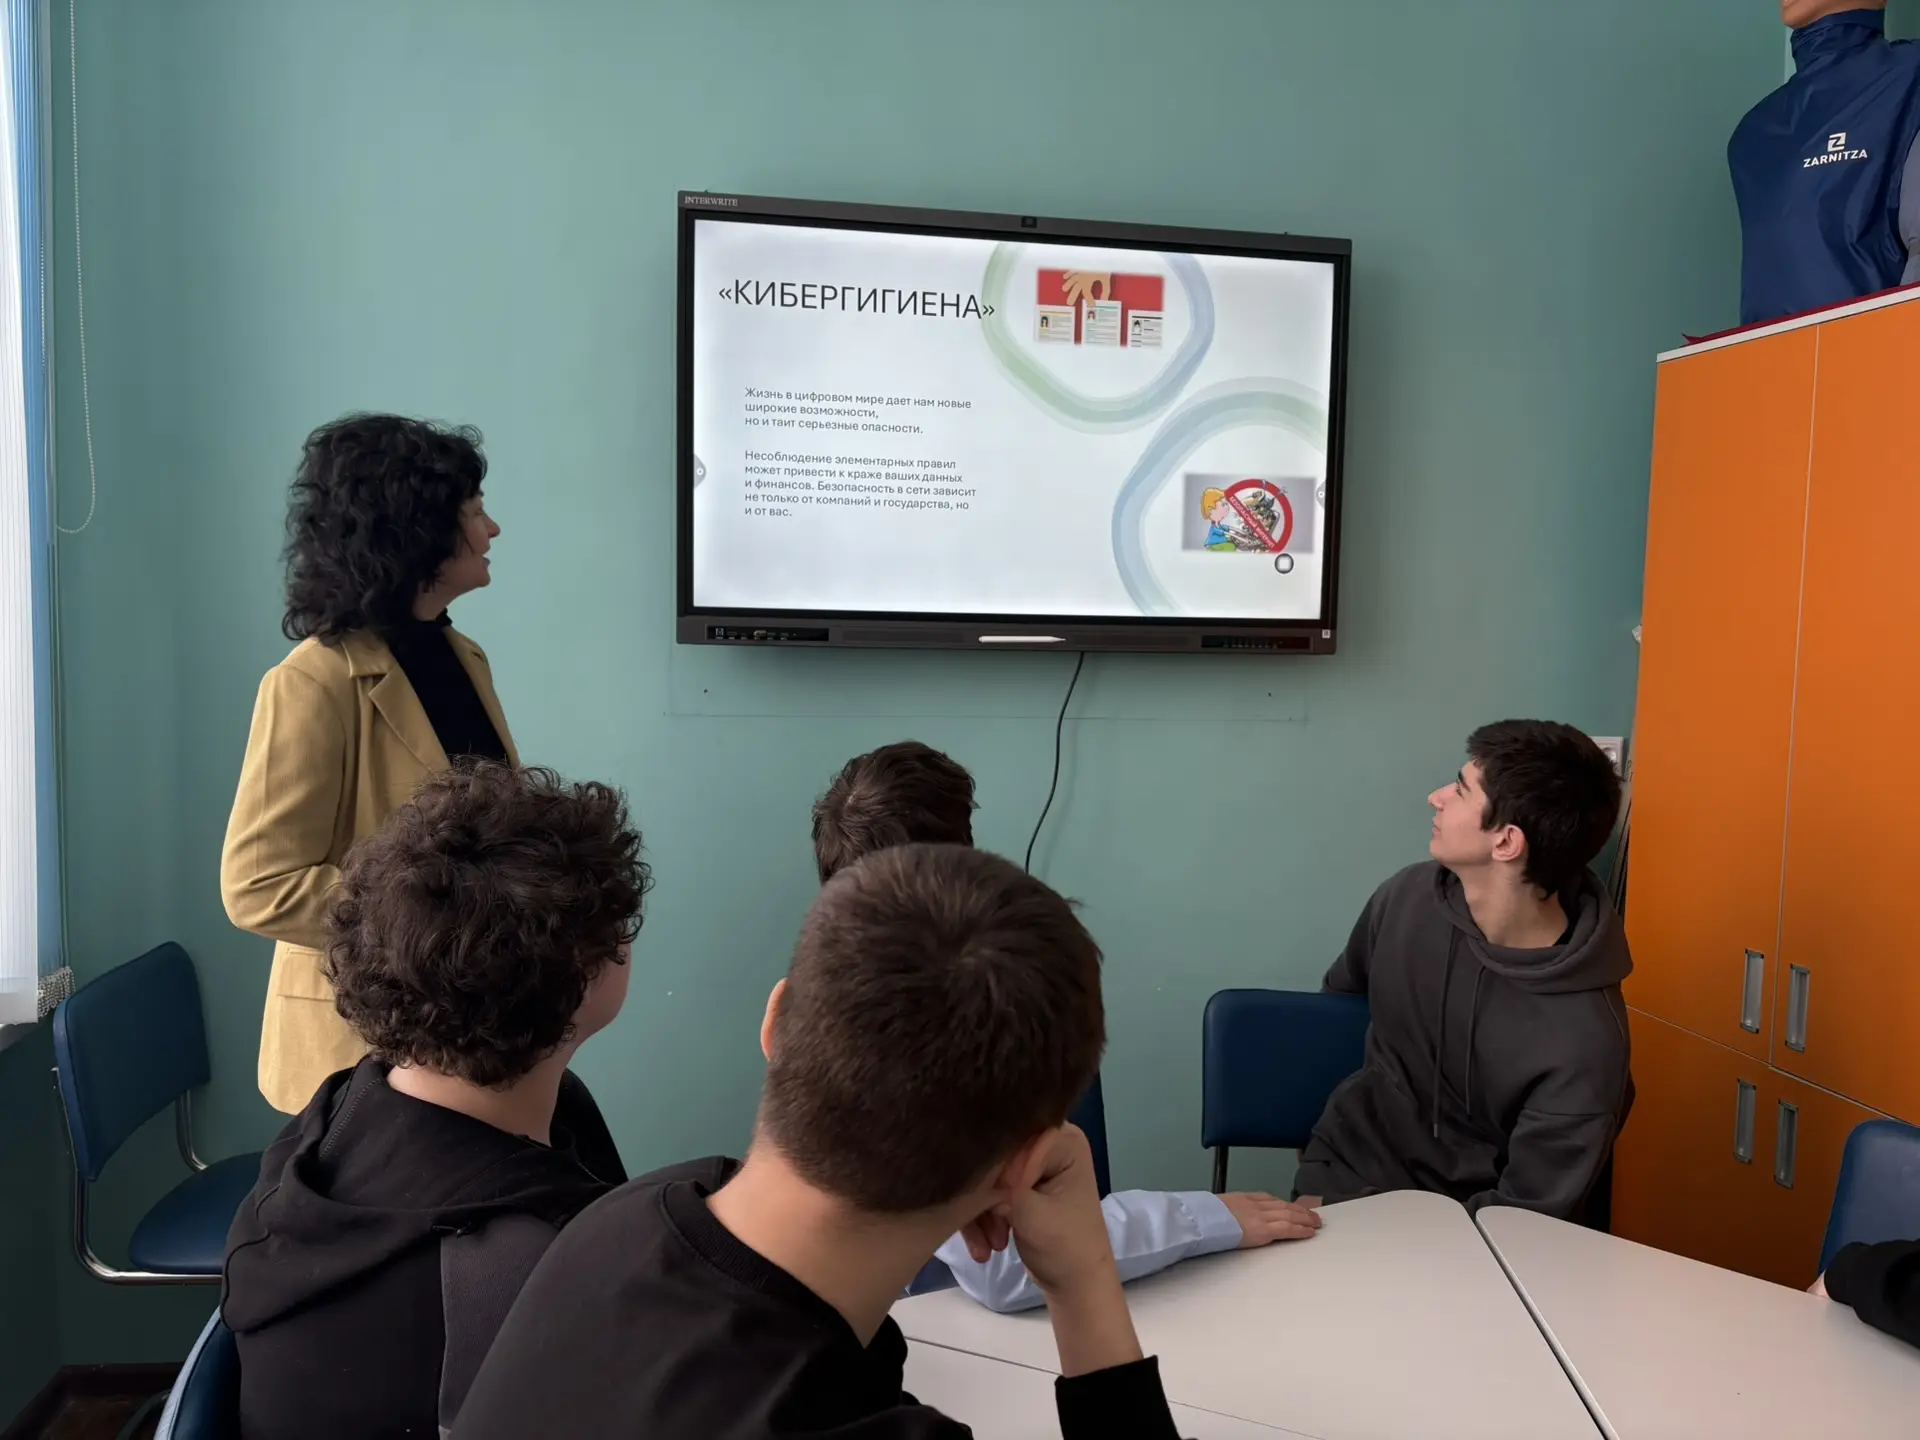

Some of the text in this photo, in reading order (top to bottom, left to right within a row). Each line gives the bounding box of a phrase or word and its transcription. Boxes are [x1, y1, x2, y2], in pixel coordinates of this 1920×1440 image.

[1803, 149, 1868, 168] ZARNITZA
[684, 196, 738, 207] INTERWRITE
[718, 279, 995, 319] «КИБЕРГИГИЕНА»
[745, 387, 971, 408] Жизнь в цифровом мире дает нам новые
[745, 404, 879, 419] широкие возможности,
[762, 418, 769, 426] и
[771, 418, 796, 428] таит
[798, 420, 859, 432] серьезные
[861, 424, 923, 434] опасности.
[745, 450, 955, 470] Несоблюдение элементарных правил
[745, 466, 963, 484] может привести к краже ваших данных
[745, 479, 976, 496] и финансов. Безопасность в сети зависит
[745, 493, 759, 502] не
[760, 494, 799, 503] только
[801, 496, 814, 504] от
[816, 496, 871, 506] компаний
[873, 498, 881, 506] и
[883, 498, 953, 510] государства,
[769, 508, 792, 516] вас.
